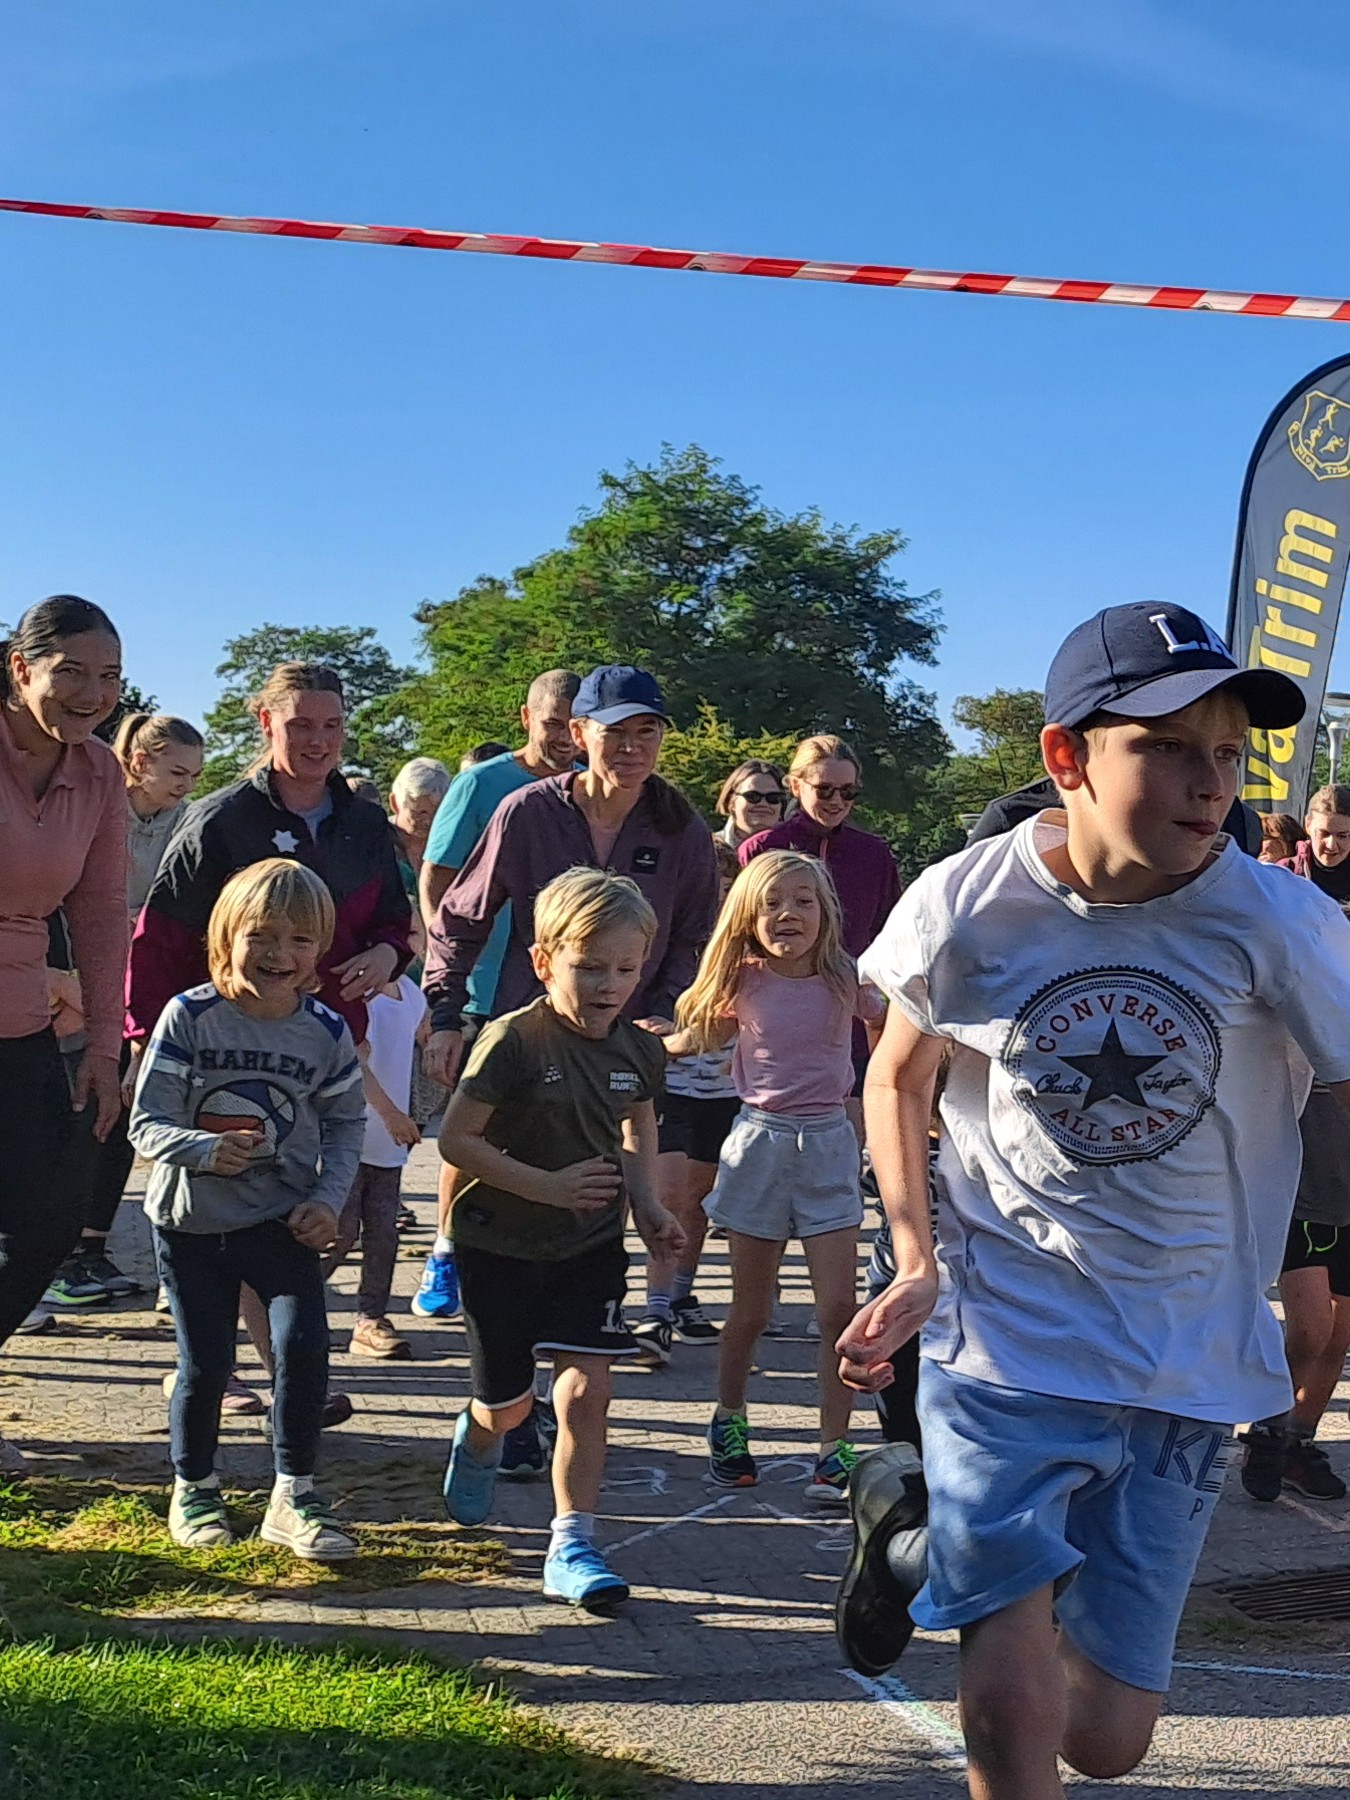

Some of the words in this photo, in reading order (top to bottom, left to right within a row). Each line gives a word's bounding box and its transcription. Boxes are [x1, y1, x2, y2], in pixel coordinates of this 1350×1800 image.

[1248, 507, 1338, 679] Trim
[1035, 993, 1188, 1054] CONVERSE
[198, 1048, 318, 1086] HARLEM
[1051, 1108, 1101, 1143] ALL
[1111, 1108, 1181, 1143] STAR
